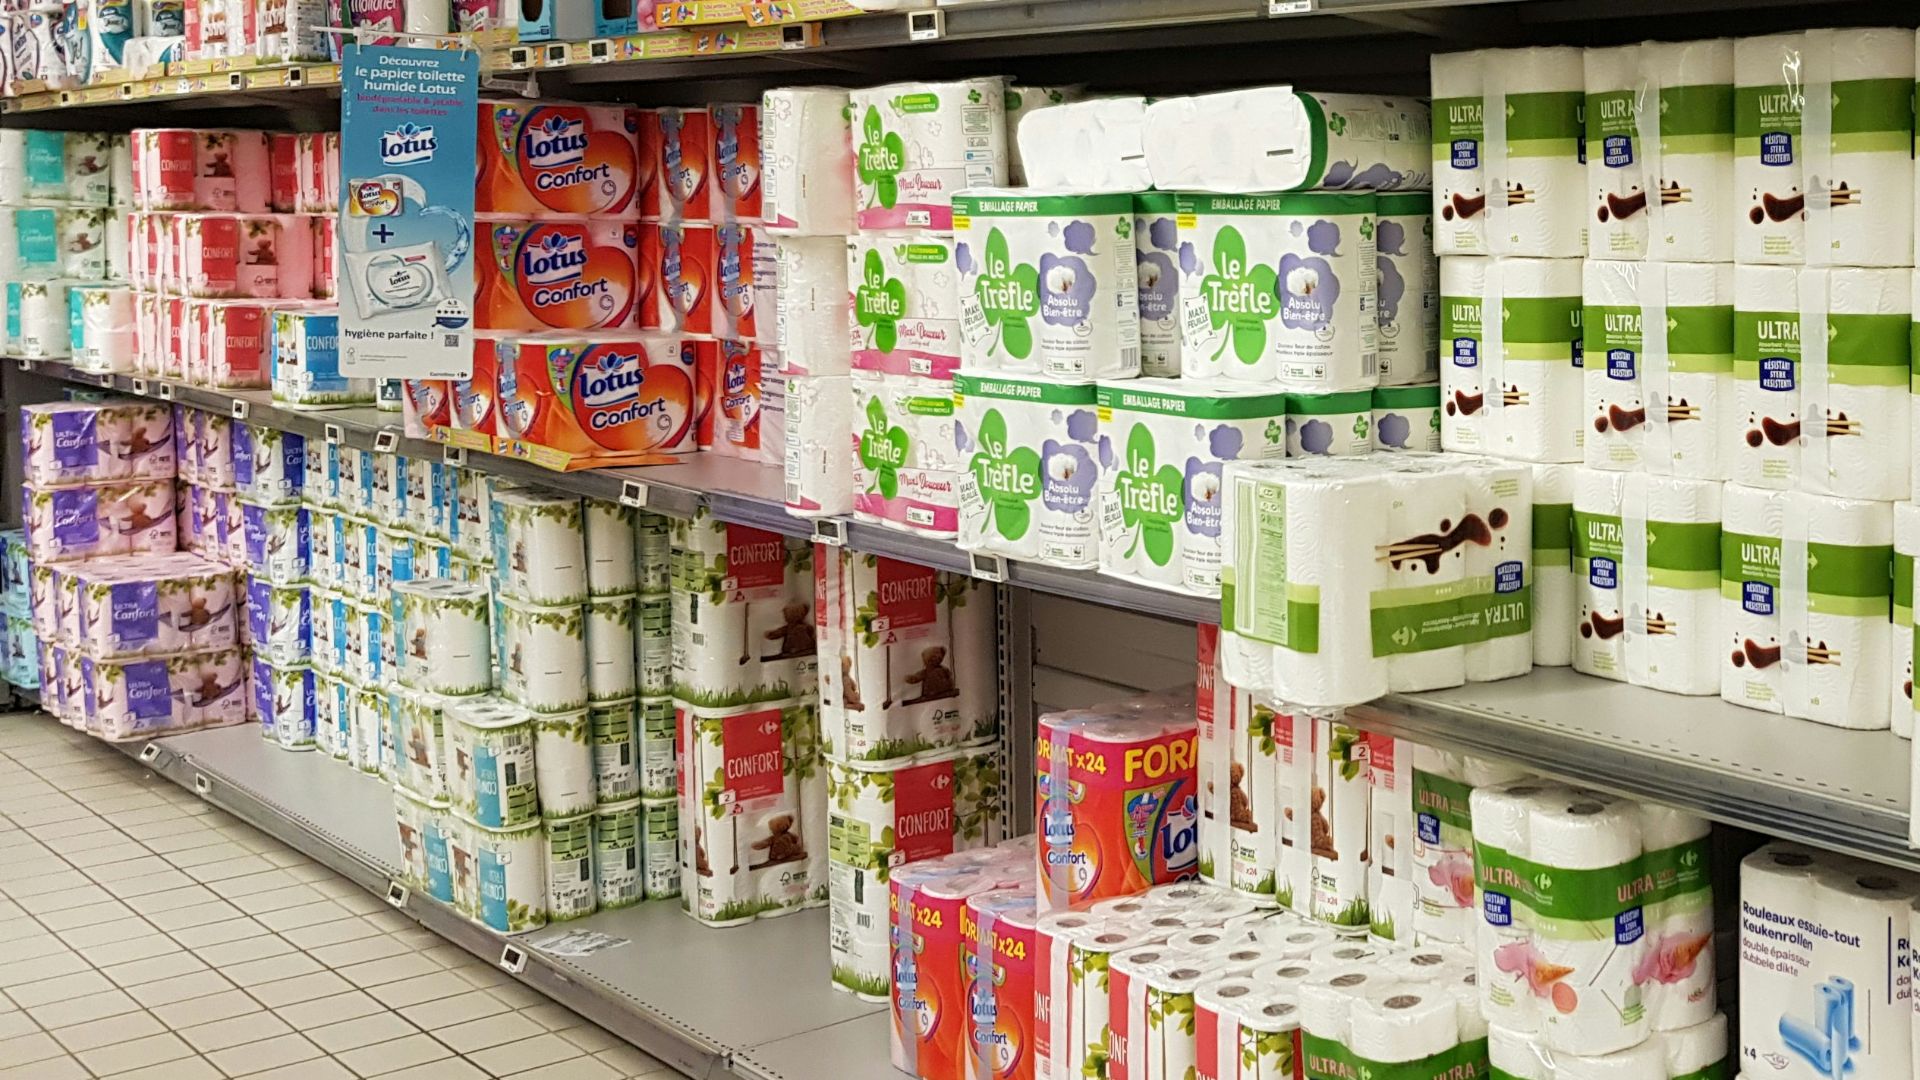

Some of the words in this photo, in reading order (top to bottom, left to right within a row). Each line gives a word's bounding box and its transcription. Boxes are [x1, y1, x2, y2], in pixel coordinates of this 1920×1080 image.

[379, 55, 440, 68] Découvrez
[355, 66, 368, 78] le
[371, 68, 413, 84] papier
[415, 68, 466, 83] toilette
[363, 79, 416, 93] humide
[419, 81, 456, 95] Lotus
[1449, 105, 1482, 123] ULTRA
[1600, 99, 1635, 119] ULTRA
[536, 163, 611, 191] Confort
[1211, 198, 1255, 211] EMBALLAGE
[1256, 198, 1281, 211] PAPIER
[988, 253, 1006, 278] le
[1221, 251, 1240, 280] le
[533, 278, 609, 307] Confort
[980, 280, 1034, 311] Trèfle
[1046, 295, 1079, 307] Absolu
[1207, 280, 1272, 314] Trèfle
[1042, 306, 1083, 318] Bien-être
[1187, 305, 1206, 319] MAXI
[1288, 298, 1322, 310] Absolu
[1452, 304, 1482, 322] ULTRA
[1187, 314, 1209, 329] FEUILLE
[1283, 310, 1326, 322] Bien-être
[1604, 314, 1642, 332] ULTRA
[344, 328, 386, 340] hygiène
[387, 330, 428, 341] parfaite
[1757, 320, 1800, 340] ULTRA
[1763, 360, 1791, 371] RÉSISTANT
[1769, 370, 1787, 379] STERK
[980, 381, 1017, 397] EMBALLAGE
[1017, 385, 1042, 398] PAPIER
[590, 396, 667, 428] Confort
[1122, 394, 1161, 409] EMBALLAGE
[1161, 398, 1187, 413] PAPIER
[985, 433, 1004, 459] le
[1132, 448, 1149, 479] le
[977, 458, 1035, 495] Trèfle
[1048, 481, 1080, 495] Absolu
[1120, 478, 1178, 516] Trèfle
[1588, 521, 1623, 542] ULTRA
[730, 541, 782, 565] CONFORT
[1741, 542, 1780, 566] ULTRA
[727, 580, 734, 589] 2
[881, 575, 934, 604] CONFORT
[878, 620, 885, 629] 2
[1484, 600, 1524, 627] ULTRA
[1358, 746, 1366, 757] 2
[727, 750, 780, 778] CONFORT
[1076, 751, 1107, 776] x24
[724, 793, 731, 802] 2
[1418, 788, 1449, 812] ULTRA
[898, 807, 951, 838] CONFORT
[893, 855, 901, 864] 2
[1482, 865, 1521, 889] ULTRA
[1616, 873, 1654, 903] ULTRA
[916, 907, 943, 929] x24
[1743, 900, 1795, 927] Rouleaux
[1797, 918, 1861, 949] essuie-tout
[1743, 917, 1813, 951] Keukenrollen
[998, 936, 1027, 961] x24
[1743, 937, 1769, 956] double
[1770, 944, 1811, 968] épaisseur
[1742, 950, 1775, 970] dubbele
[1776, 959, 1799, 977] dikte
[1309, 1053, 1347, 1078] ULTRA
